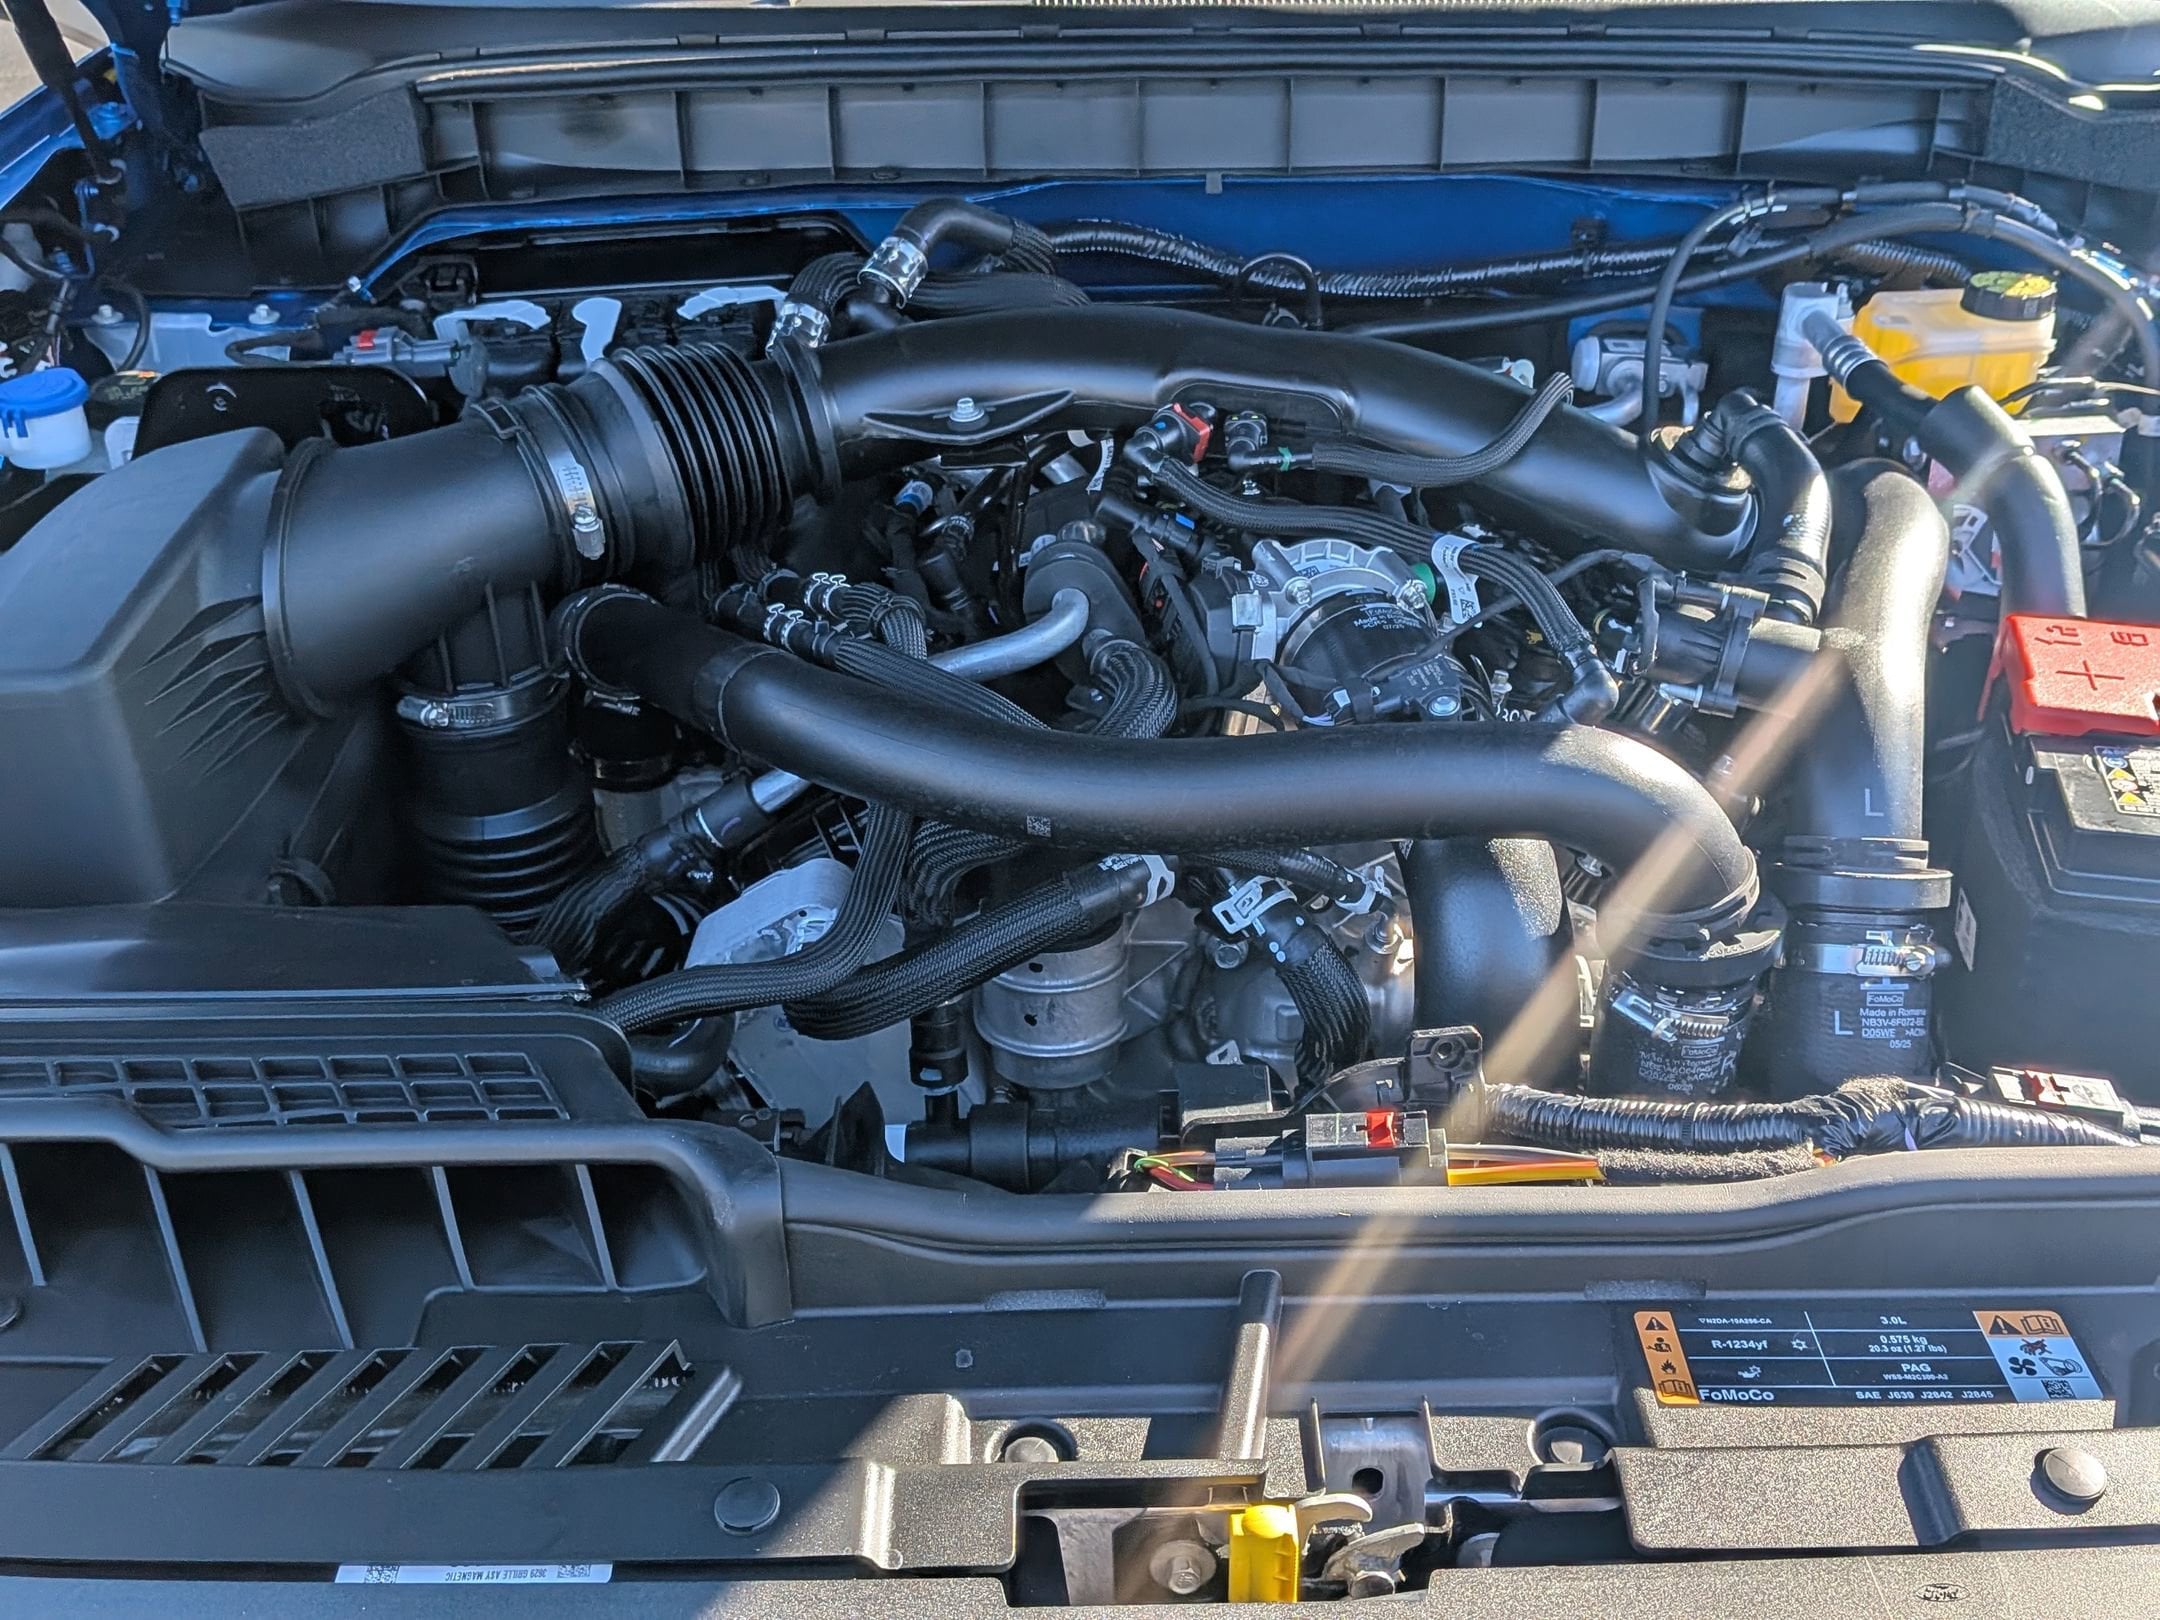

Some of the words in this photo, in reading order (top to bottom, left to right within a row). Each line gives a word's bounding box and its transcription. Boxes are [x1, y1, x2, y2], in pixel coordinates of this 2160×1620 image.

[1864, 788, 1884, 817] L
[1868, 994, 1903, 1004] FoMoCo
[1860, 1007, 1886, 1017] Made
[1888, 1008, 1897, 1017] in
[1834, 1010, 1854, 1035] L
[1879, 1316, 1907, 1325] 3.0L
[1711, 1339, 1769, 1351] R-1234yf
[1879, 1335, 1909, 1344] 0.575
[1911, 1335, 1928, 1346] kg
[1868, 1345, 1889, 1353] 20.3
[1904, 1345, 1926, 1354] (1.27
[1927, 1344, 1948, 1354] lbs)
[1901, 1363, 1932, 1373] PAG
[1700, 1388, 1775, 1401] FoMoCo
[1855, 1391, 1882, 1399] SAE
[1920, 1390, 1954, 1399] J2842
[445, 1571, 484, 1582] MAGNETIC
[485, 1570, 502, 1580] ASY
[503, 1569, 529, 1580] GRILLE
